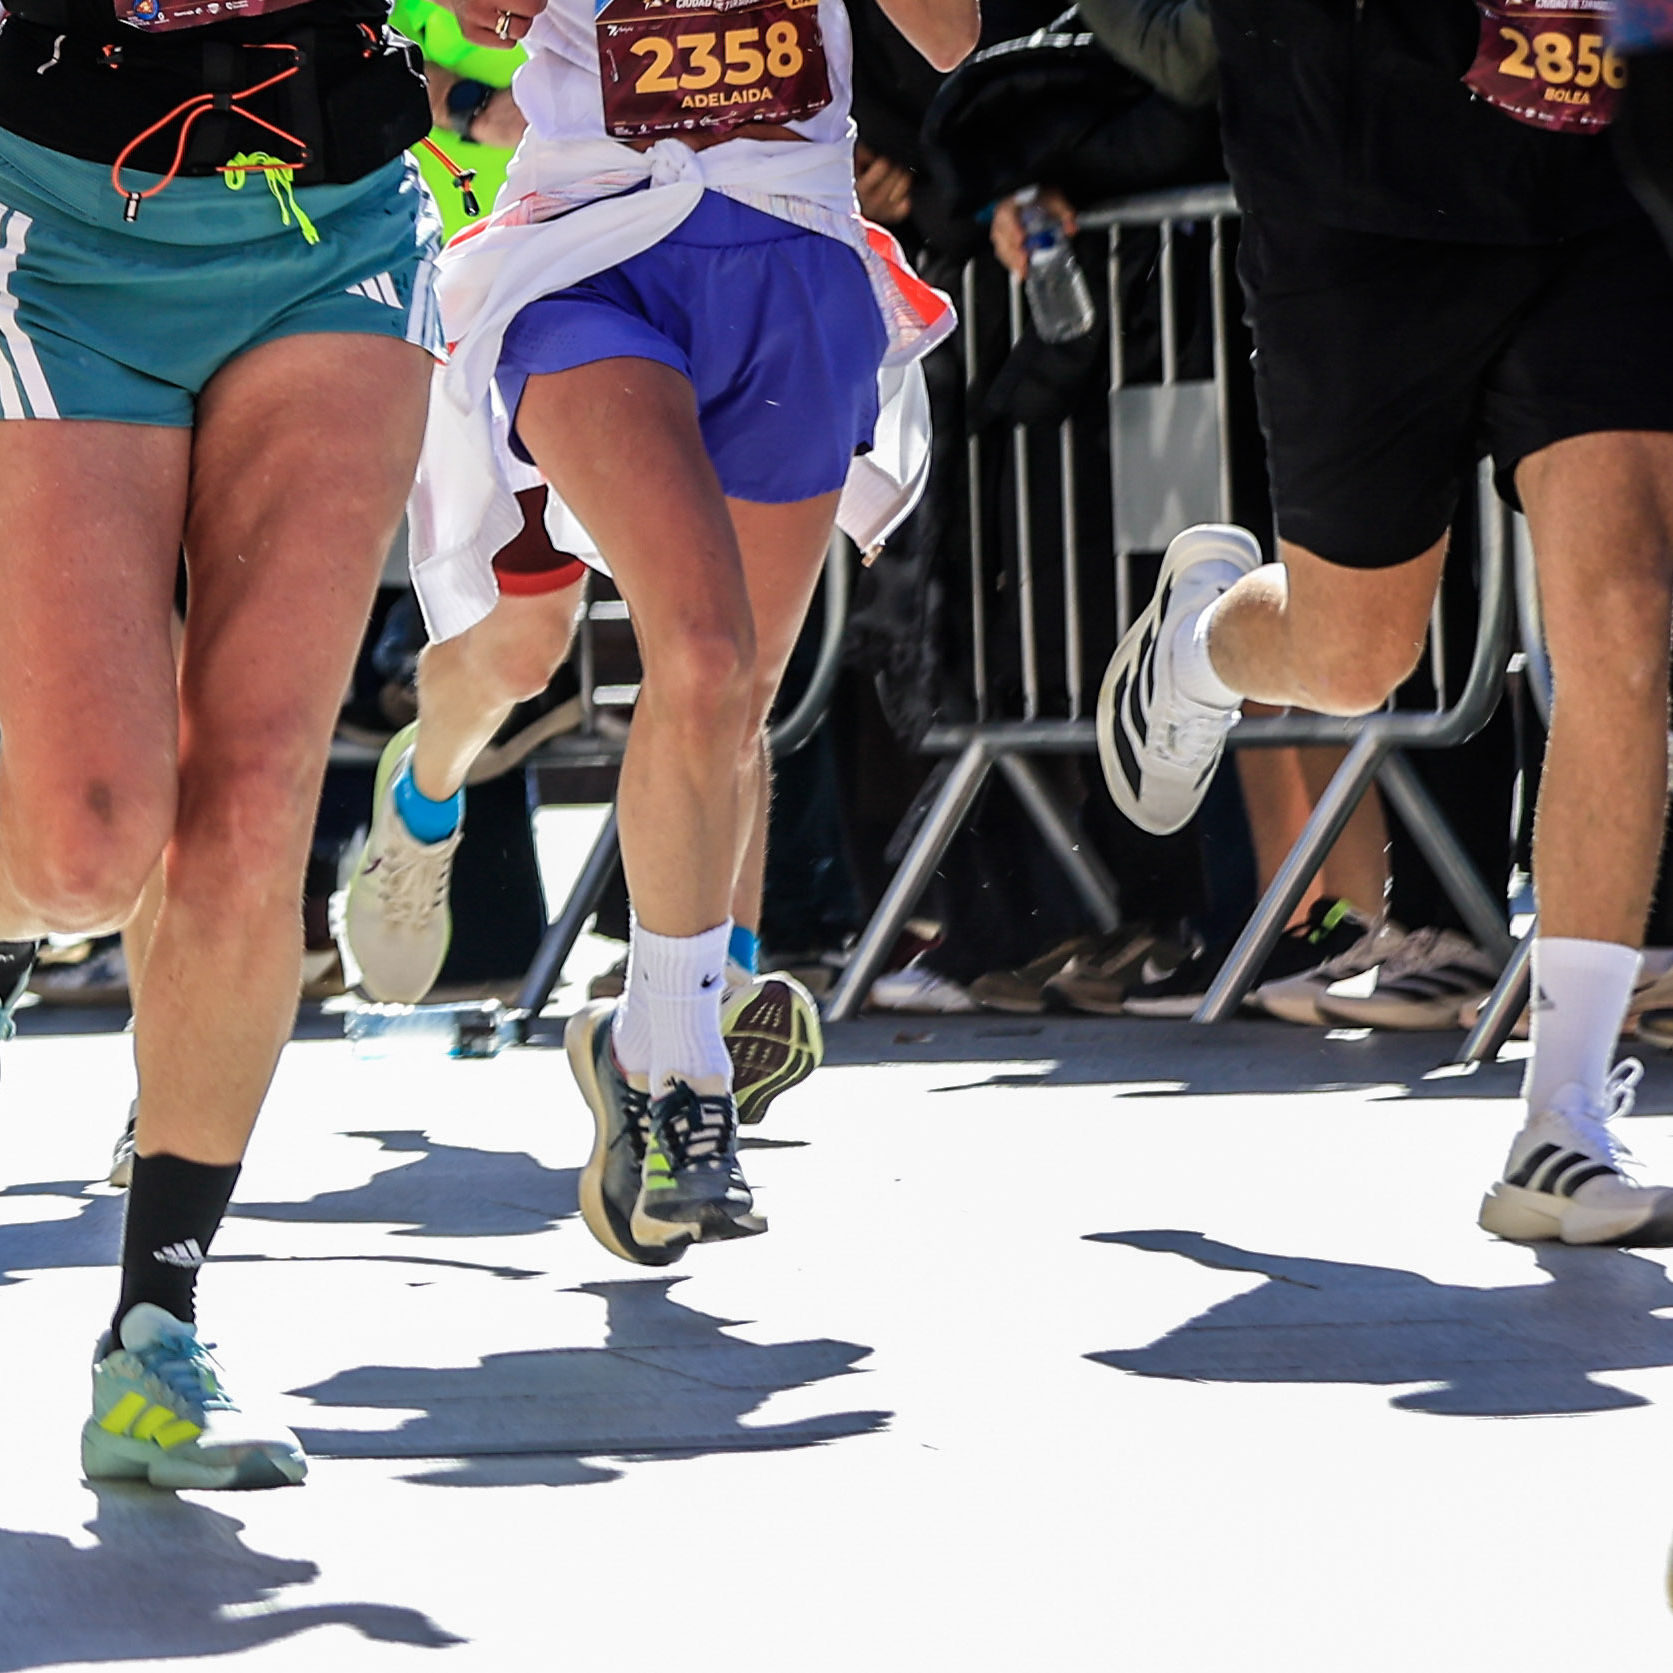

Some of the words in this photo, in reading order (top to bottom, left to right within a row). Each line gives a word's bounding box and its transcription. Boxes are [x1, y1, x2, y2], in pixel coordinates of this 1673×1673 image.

[629, 21, 804, 94] 2358
[1498, 27, 1628, 89] 2856
[681, 87, 773, 108] ADELAIDA
[1544, 87, 1590, 105] BOLEA
